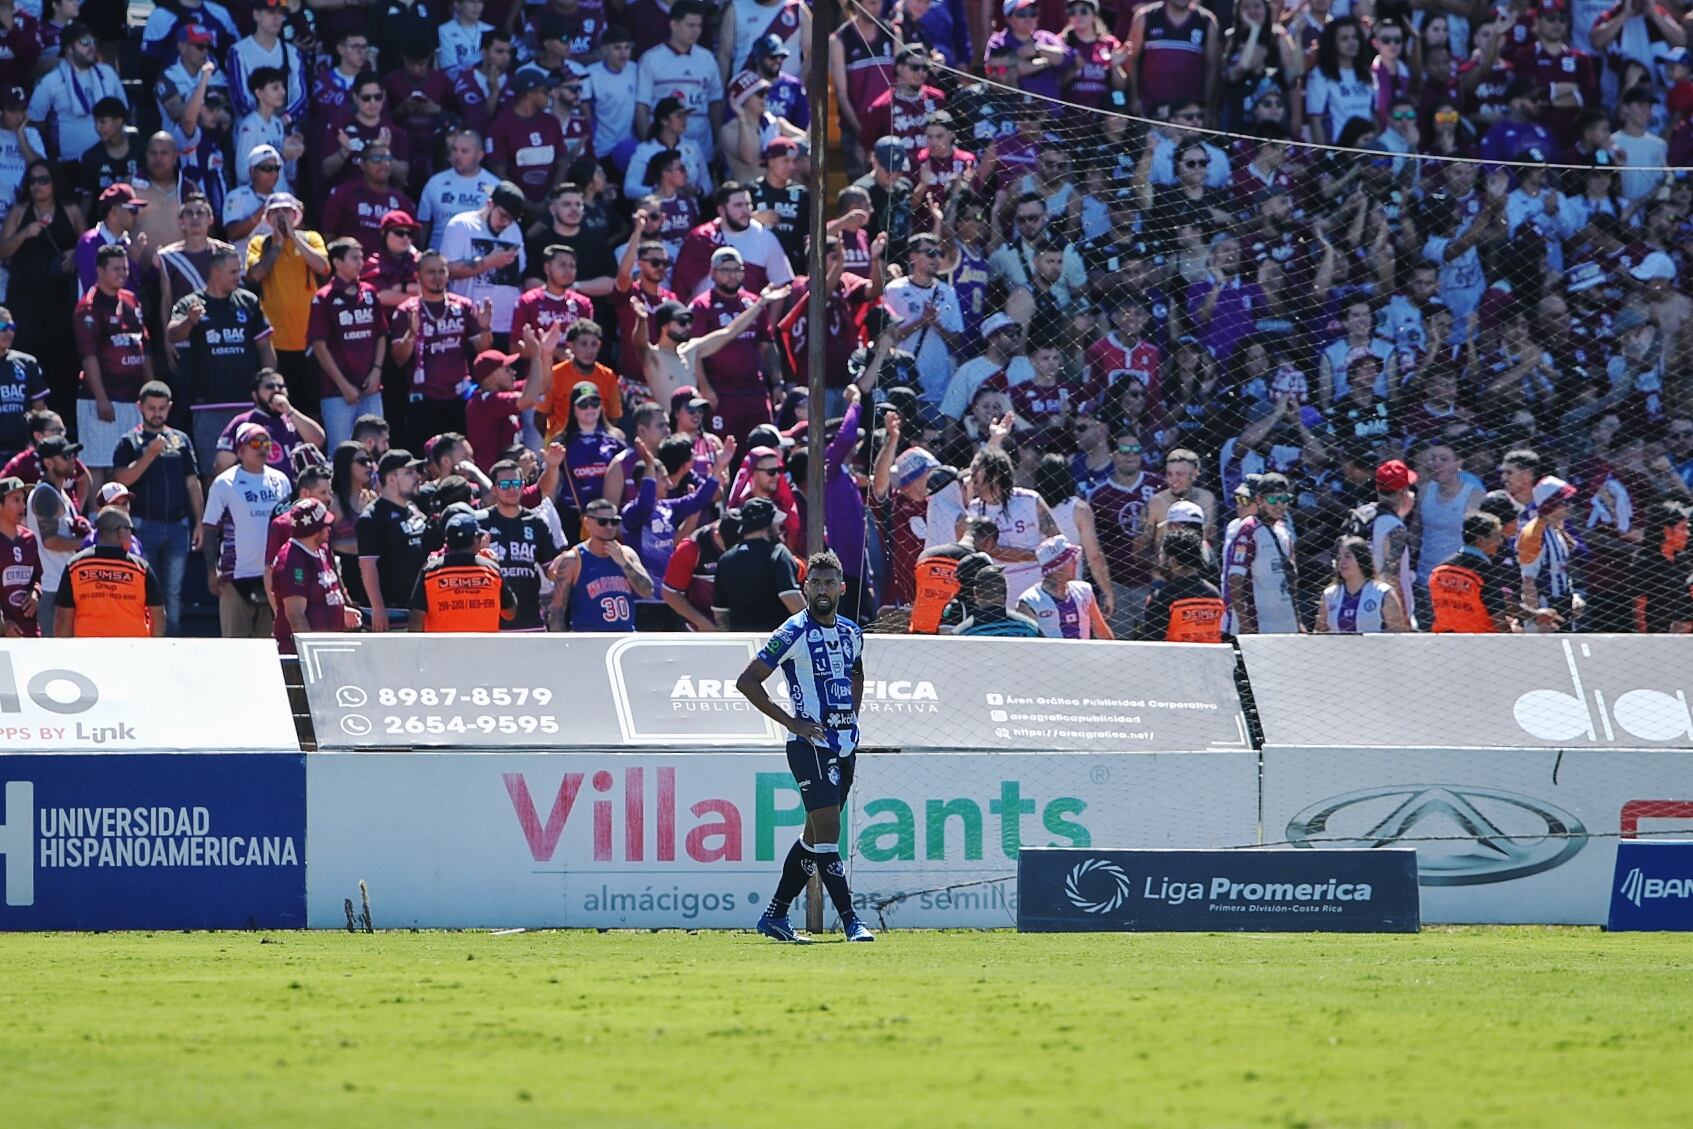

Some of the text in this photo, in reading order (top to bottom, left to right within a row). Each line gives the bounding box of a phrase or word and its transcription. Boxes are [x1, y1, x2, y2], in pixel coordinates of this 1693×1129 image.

[601, 597, 630, 622] 30
[378, 687, 553, 706] 8987-8579
[670, 675, 741, 699] ÁRE
[0, 727, 31, 740] PS
[39, 727, 66, 740] BY
[383, 715, 560, 734] 2654-9595
[41, 807, 210, 837] UNIVERSIDAD
[41, 836, 298, 868] HISPANOAMERICANA
[584, 884, 736, 919] almácigos
[1144, 877, 1372, 905] Liga Promerica
[1209, 904, 1246, 912] Primera
[1322, 904, 1343, 912] Rica
